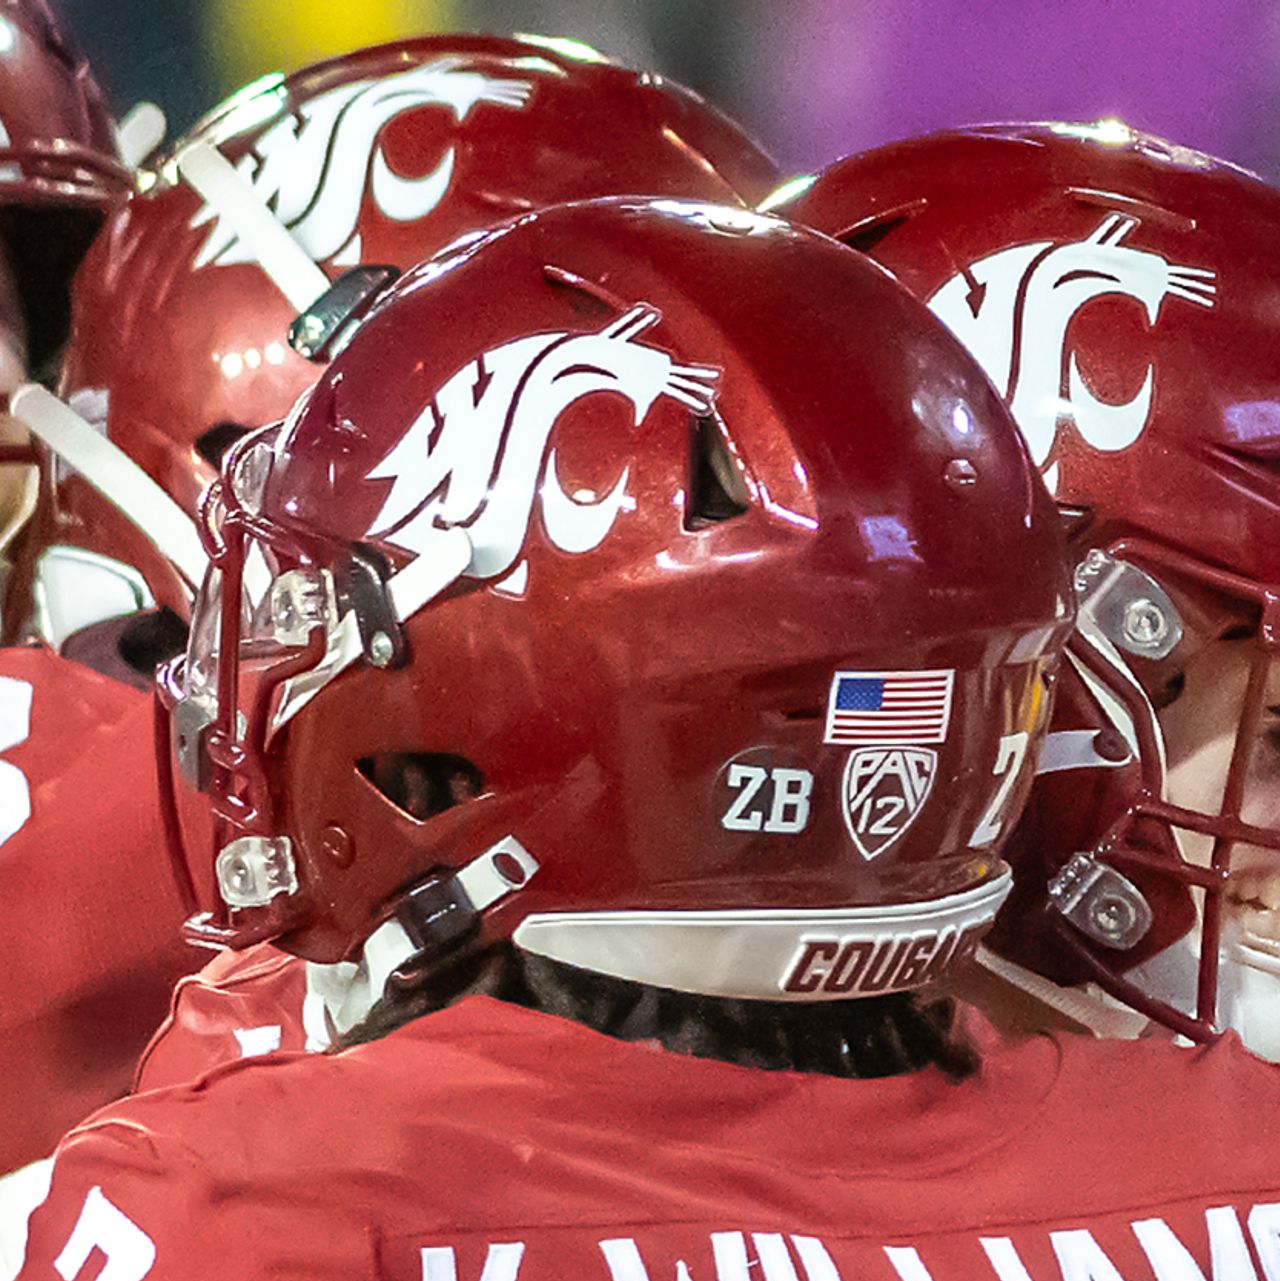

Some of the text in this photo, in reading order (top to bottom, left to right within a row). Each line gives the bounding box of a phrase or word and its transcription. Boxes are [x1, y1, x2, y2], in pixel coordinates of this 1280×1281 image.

[721, 763, 815, 833] ZB
[849, 751, 933, 814] PAC
[857, 796, 906, 834] 12
